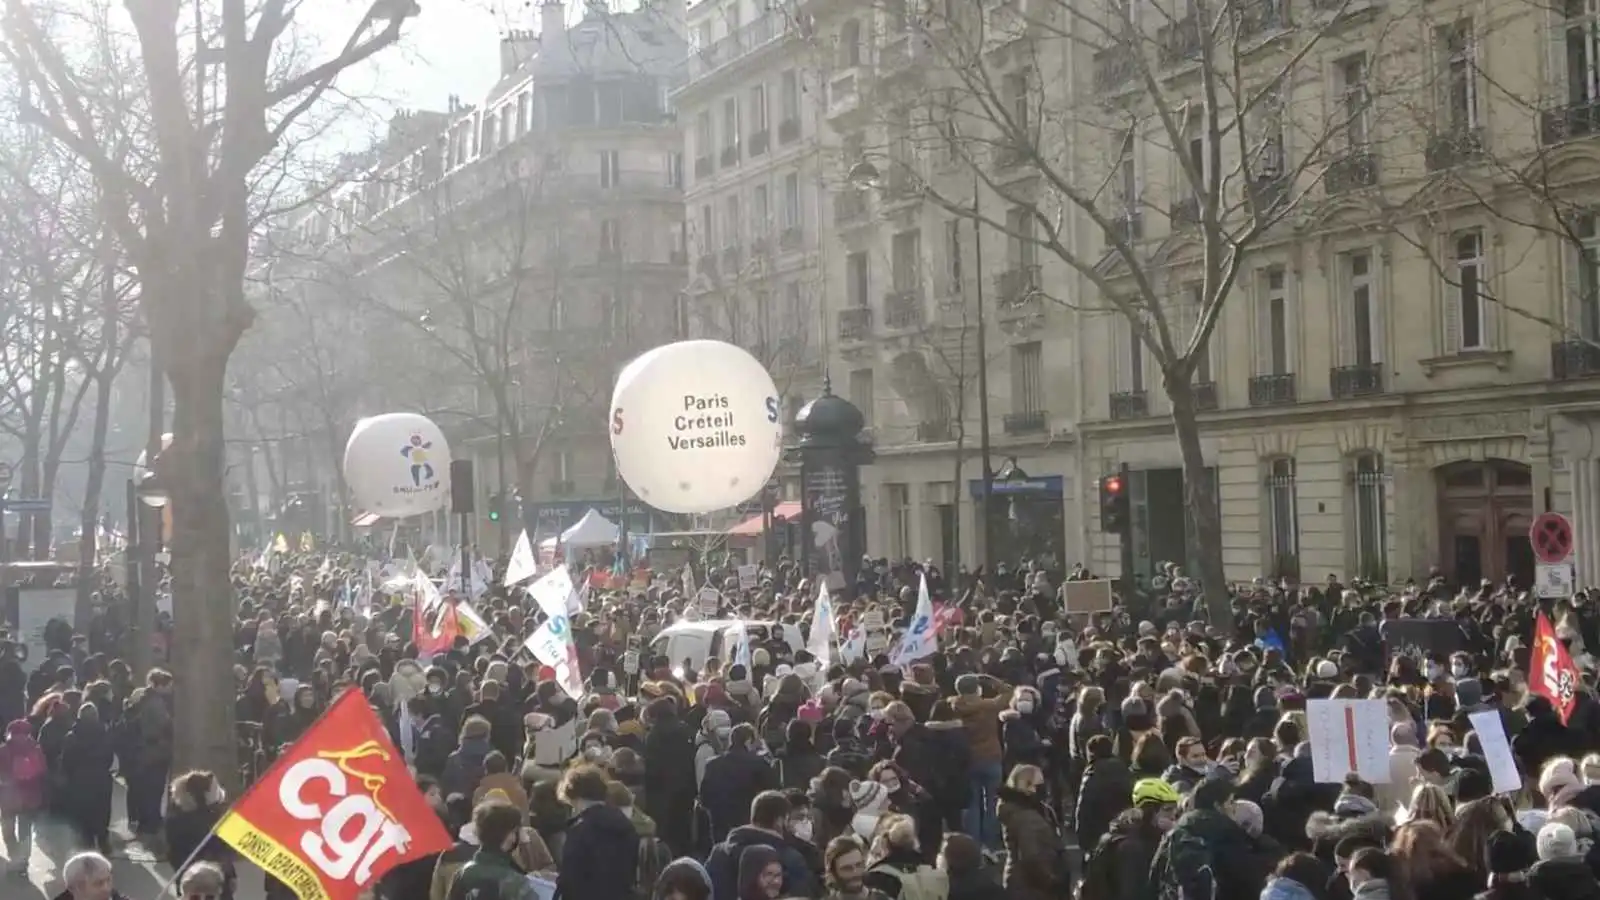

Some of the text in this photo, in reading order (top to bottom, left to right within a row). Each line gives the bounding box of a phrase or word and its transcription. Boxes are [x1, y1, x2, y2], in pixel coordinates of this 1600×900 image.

[684, 393, 729, 411] Paris
[674, 412, 734, 431] Créteil
[667, 432, 746, 450] Versailles
[279, 757, 413, 886] cgt
[237, 831, 275, 865] CONSEIL
